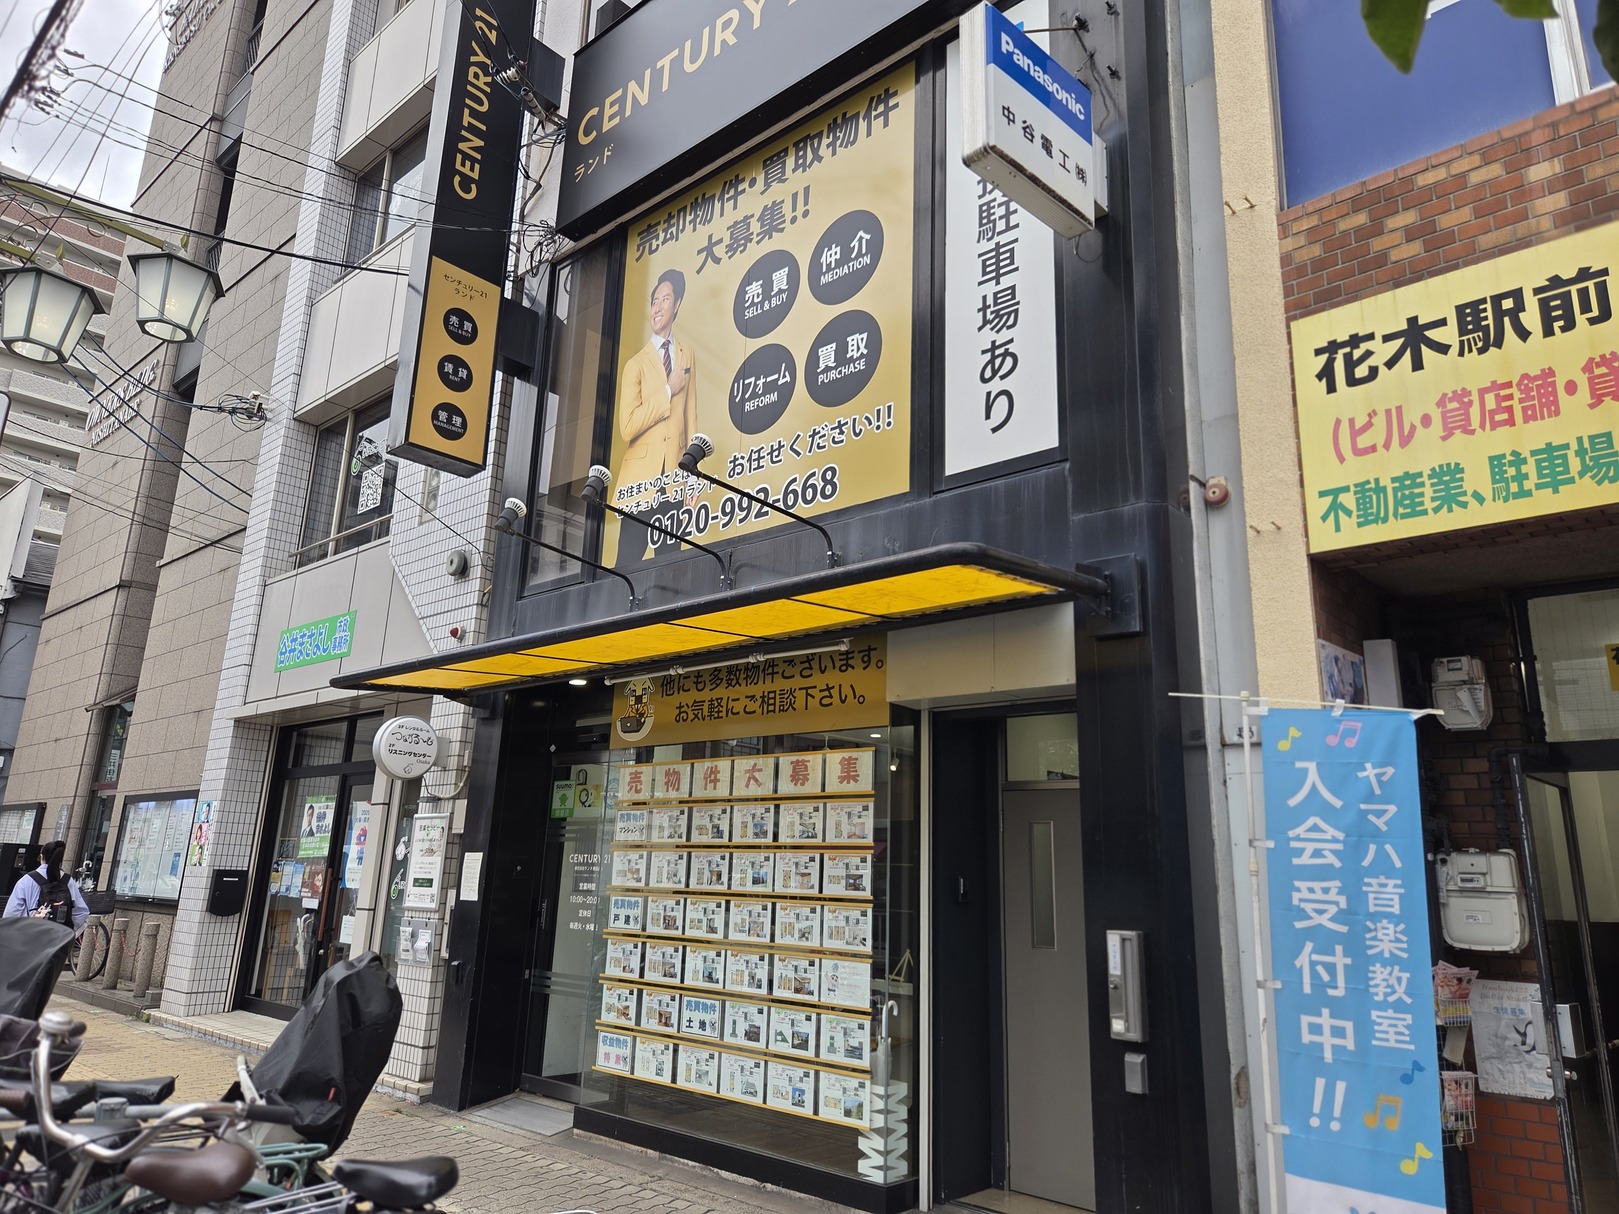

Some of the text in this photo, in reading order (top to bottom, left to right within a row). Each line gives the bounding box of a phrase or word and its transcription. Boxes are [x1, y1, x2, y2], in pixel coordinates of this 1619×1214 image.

[578, 0, 766, 145] CENTURY
[1000, 31, 1085, 121] Panasonic
[453, 7, 498, 200] CENTURY 21
[574, 144, 614, 183] ランド
[635, 86, 900, 263] 売却物件・買取物件
[695, 184, 811, 275] 大募集!!
[819, 229, 872, 272] 仲介
[444, 274, 488, 298] センチュリー21
[819, 253, 872, 286] MEDIATION
[454, 287, 475, 301] ランド
[744, 266, 790, 307] 売買
[744, 301, 763, 320] SELL
[771, 292, 788, 310] BUY
[448, 325, 458, 333] SELL
[449, 315, 473, 333] 売買
[1313, 265, 1613, 396] 花木駅前
[816, 331, 869, 373] 買取
[443, 361, 468, 380] 賃貸
[449, 374, 461, 383] RENT
[733, 362, 791, 403] リフォーム
[817, 358, 866, 386] PURCHASE
[437, 410, 463, 428] 管理
[744, 392, 778, 413] REFORM
[433, 420, 464, 434] MANAGEMENT
[726, 402, 895, 481] お任せください!!
[616, 469, 691, 502] お住まいのことは
[1317, 430, 1619, 534] 不動産業、駐車場
[648, 464, 839, 549] 0120-992-668
[277, 623, 331, 668] 谷井まさよし
[660, 644, 884, 698] 他にも多数物件ございます。
[674, 682, 866, 724] お気軽にご相談下さい。
[388, 748, 432, 759] リスニングセンター
[618, 826, 638, 834] マンション
[619, 812, 646, 823] 売買物件
[604, 854, 611, 864] 21
[613, 898, 640, 910] 売買物件
[1356, 761, 1415, 1051] ヤマハ音楽教室
[1286, 760, 1355, 1132] 入会受付中!!
[685, 999, 717, 1015] 売買物件
[685, 1017, 707, 1032] 土地
[601, 1034, 629, 1050] 収益物件
